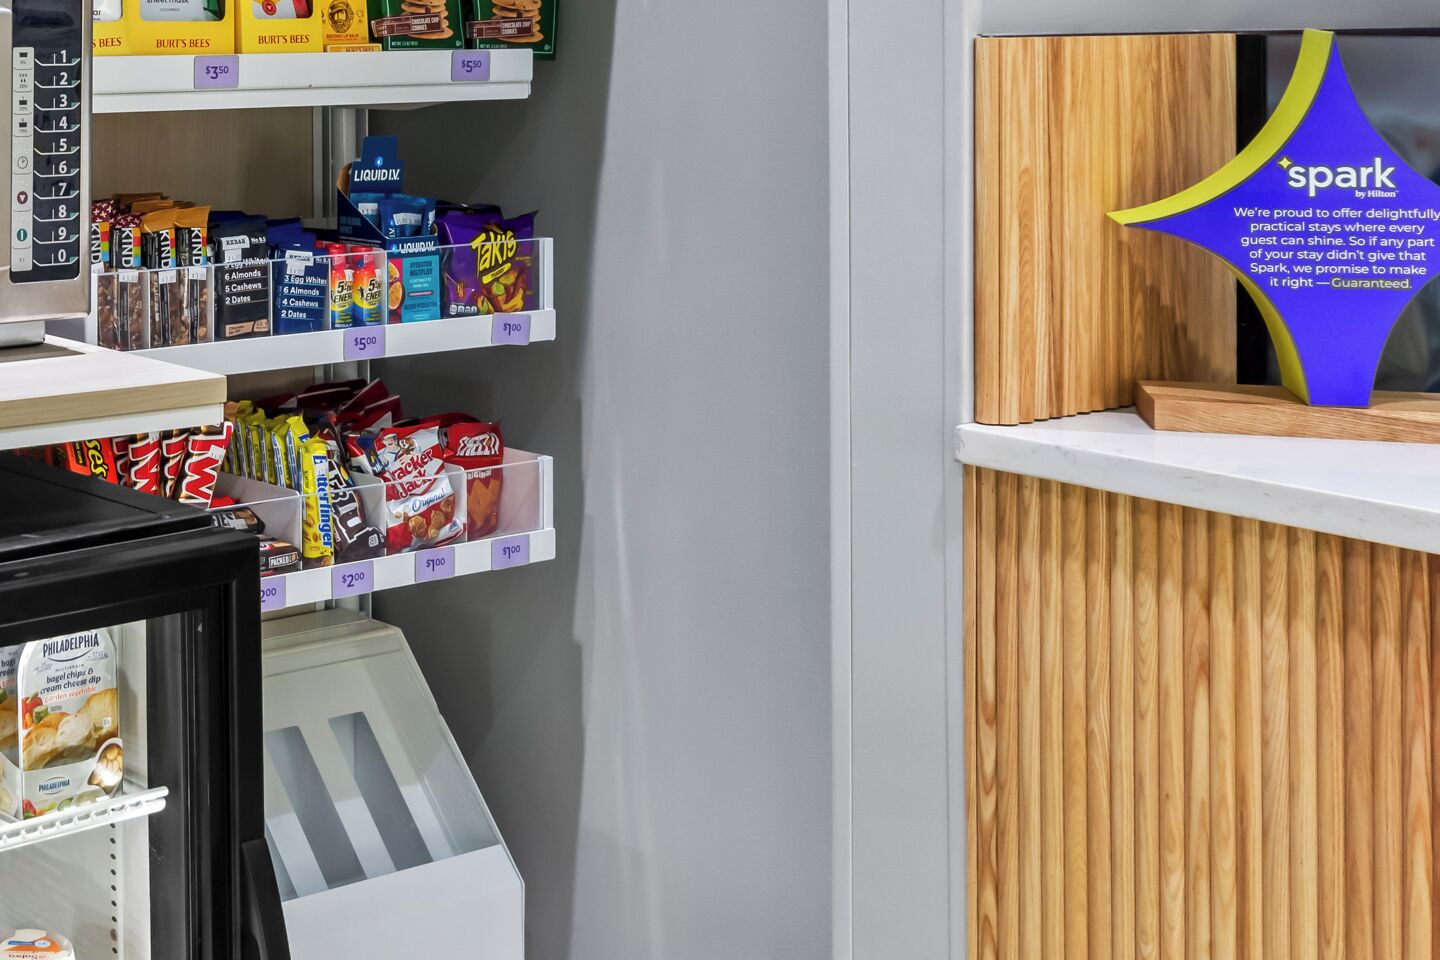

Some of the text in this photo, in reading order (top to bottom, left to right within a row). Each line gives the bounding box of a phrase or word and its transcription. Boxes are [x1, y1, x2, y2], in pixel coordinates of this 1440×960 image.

[156, 38, 210, 48] BURT'S BEES
[60, 72, 68, 86] 2
[354, 169, 387, 181] LIQUID
[1288, 157, 1396, 197] spark
[1355, 190, 1366, 198] by
[1234, 208, 1440, 221] We're proud to offer delightfully
[1250, 222, 1425, 234] practical stays where every
[121, 228, 133, 267] KIND
[1241, 236, 1435, 248] guest can shine. So if any part
[471, 231, 517, 273] Takis
[1250, 249, 1426, 262] of your stay didn't give that
[231, 270, 261, 280] Almonds
[1250, 263, 1427, 275] Spark, we promise to make
[1270, 277, 1412, 289] it right Guaranteed.
[43, 633, 99, 658] PHILADELPHIA
[40, 676, 101, 694] cream cheese dip
